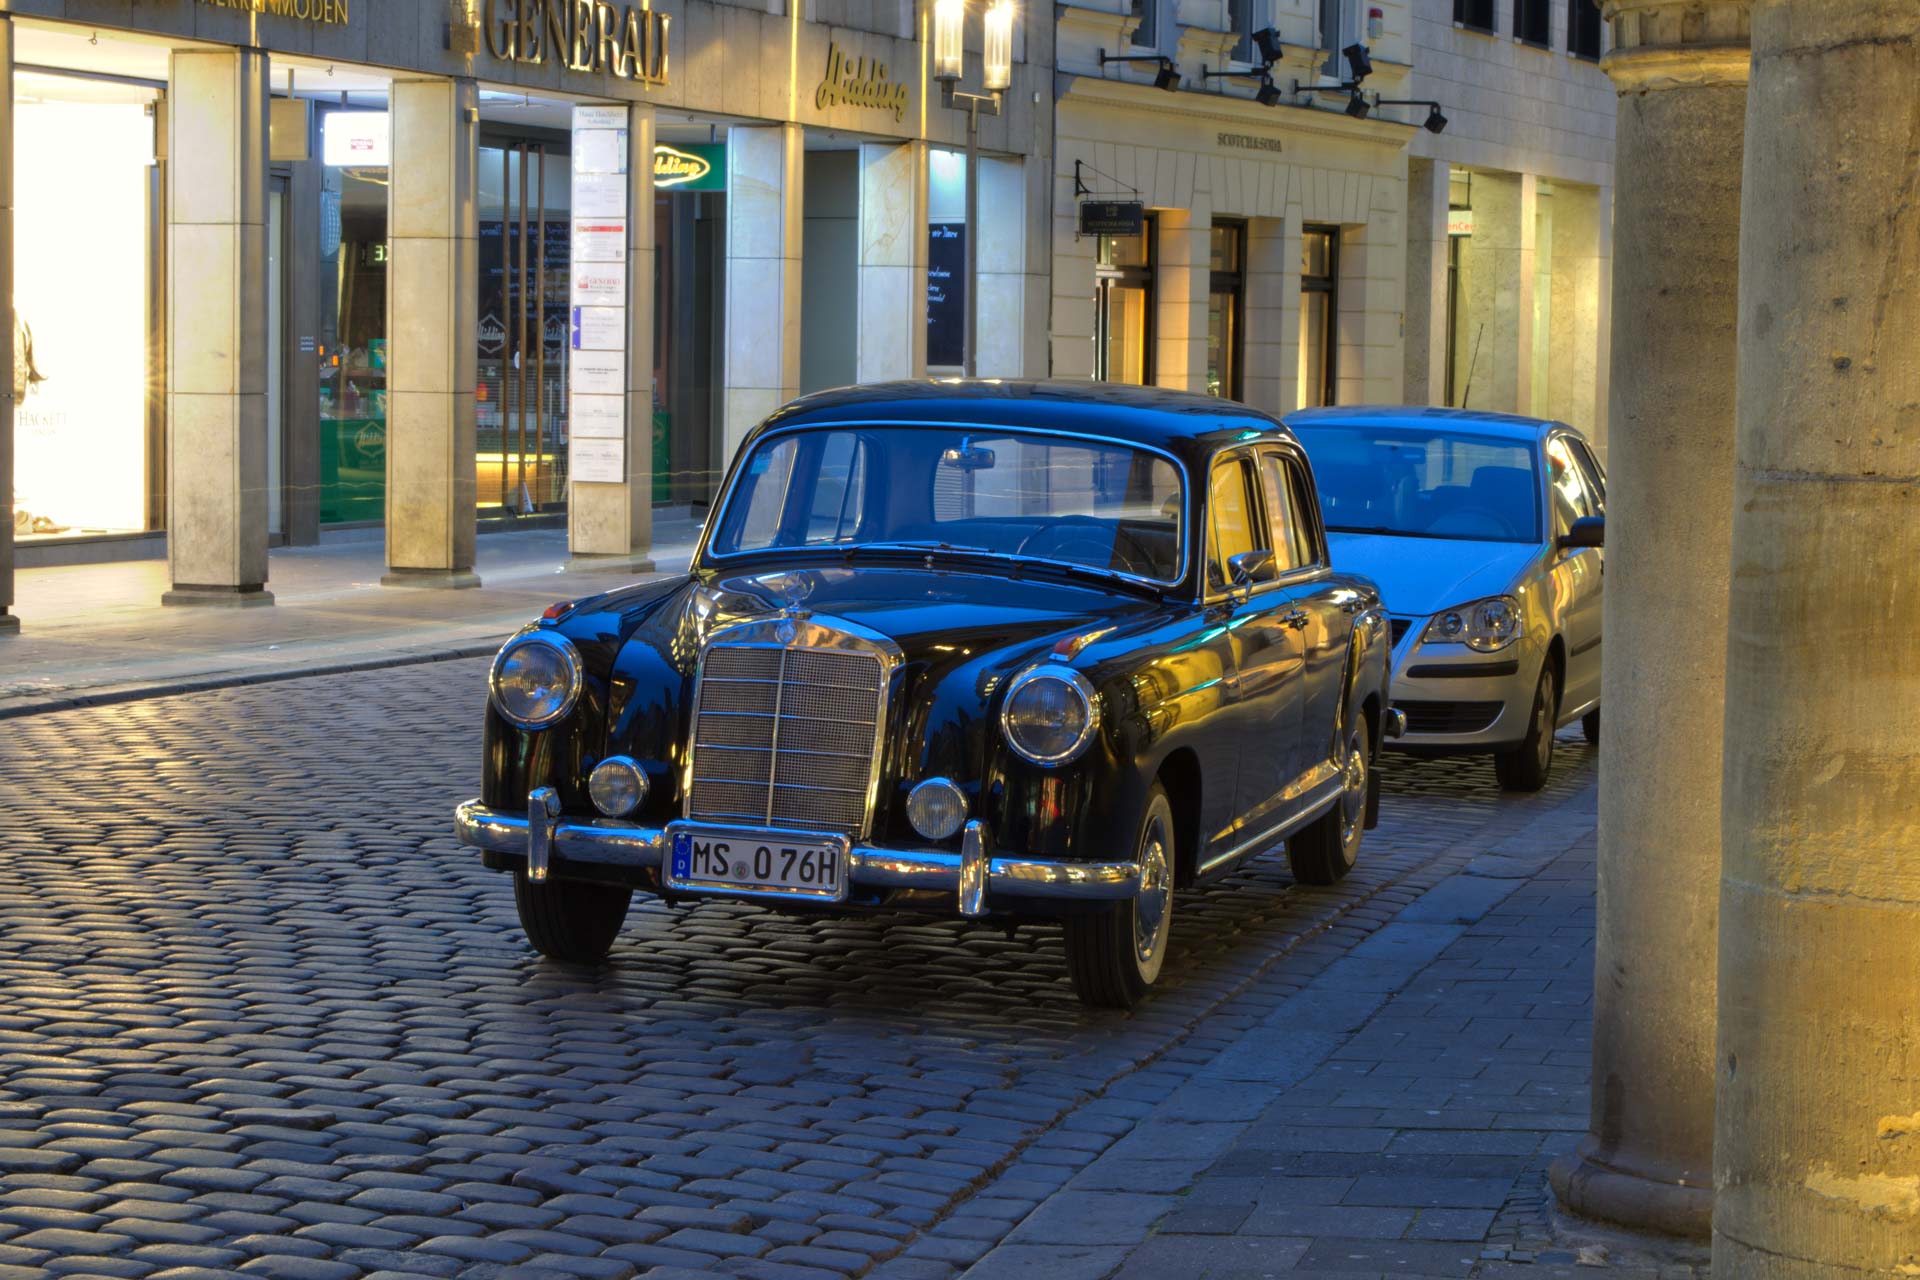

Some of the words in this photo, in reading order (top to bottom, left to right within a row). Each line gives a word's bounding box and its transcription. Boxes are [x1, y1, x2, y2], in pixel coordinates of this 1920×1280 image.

[485, 0, 671, 85] GENERALI
[816, 41, 909, 123] Hidding
[677, 859, 686, 871] D
[692, 841, 730, 876] MS
[780, 849, 836, 884] 76H
